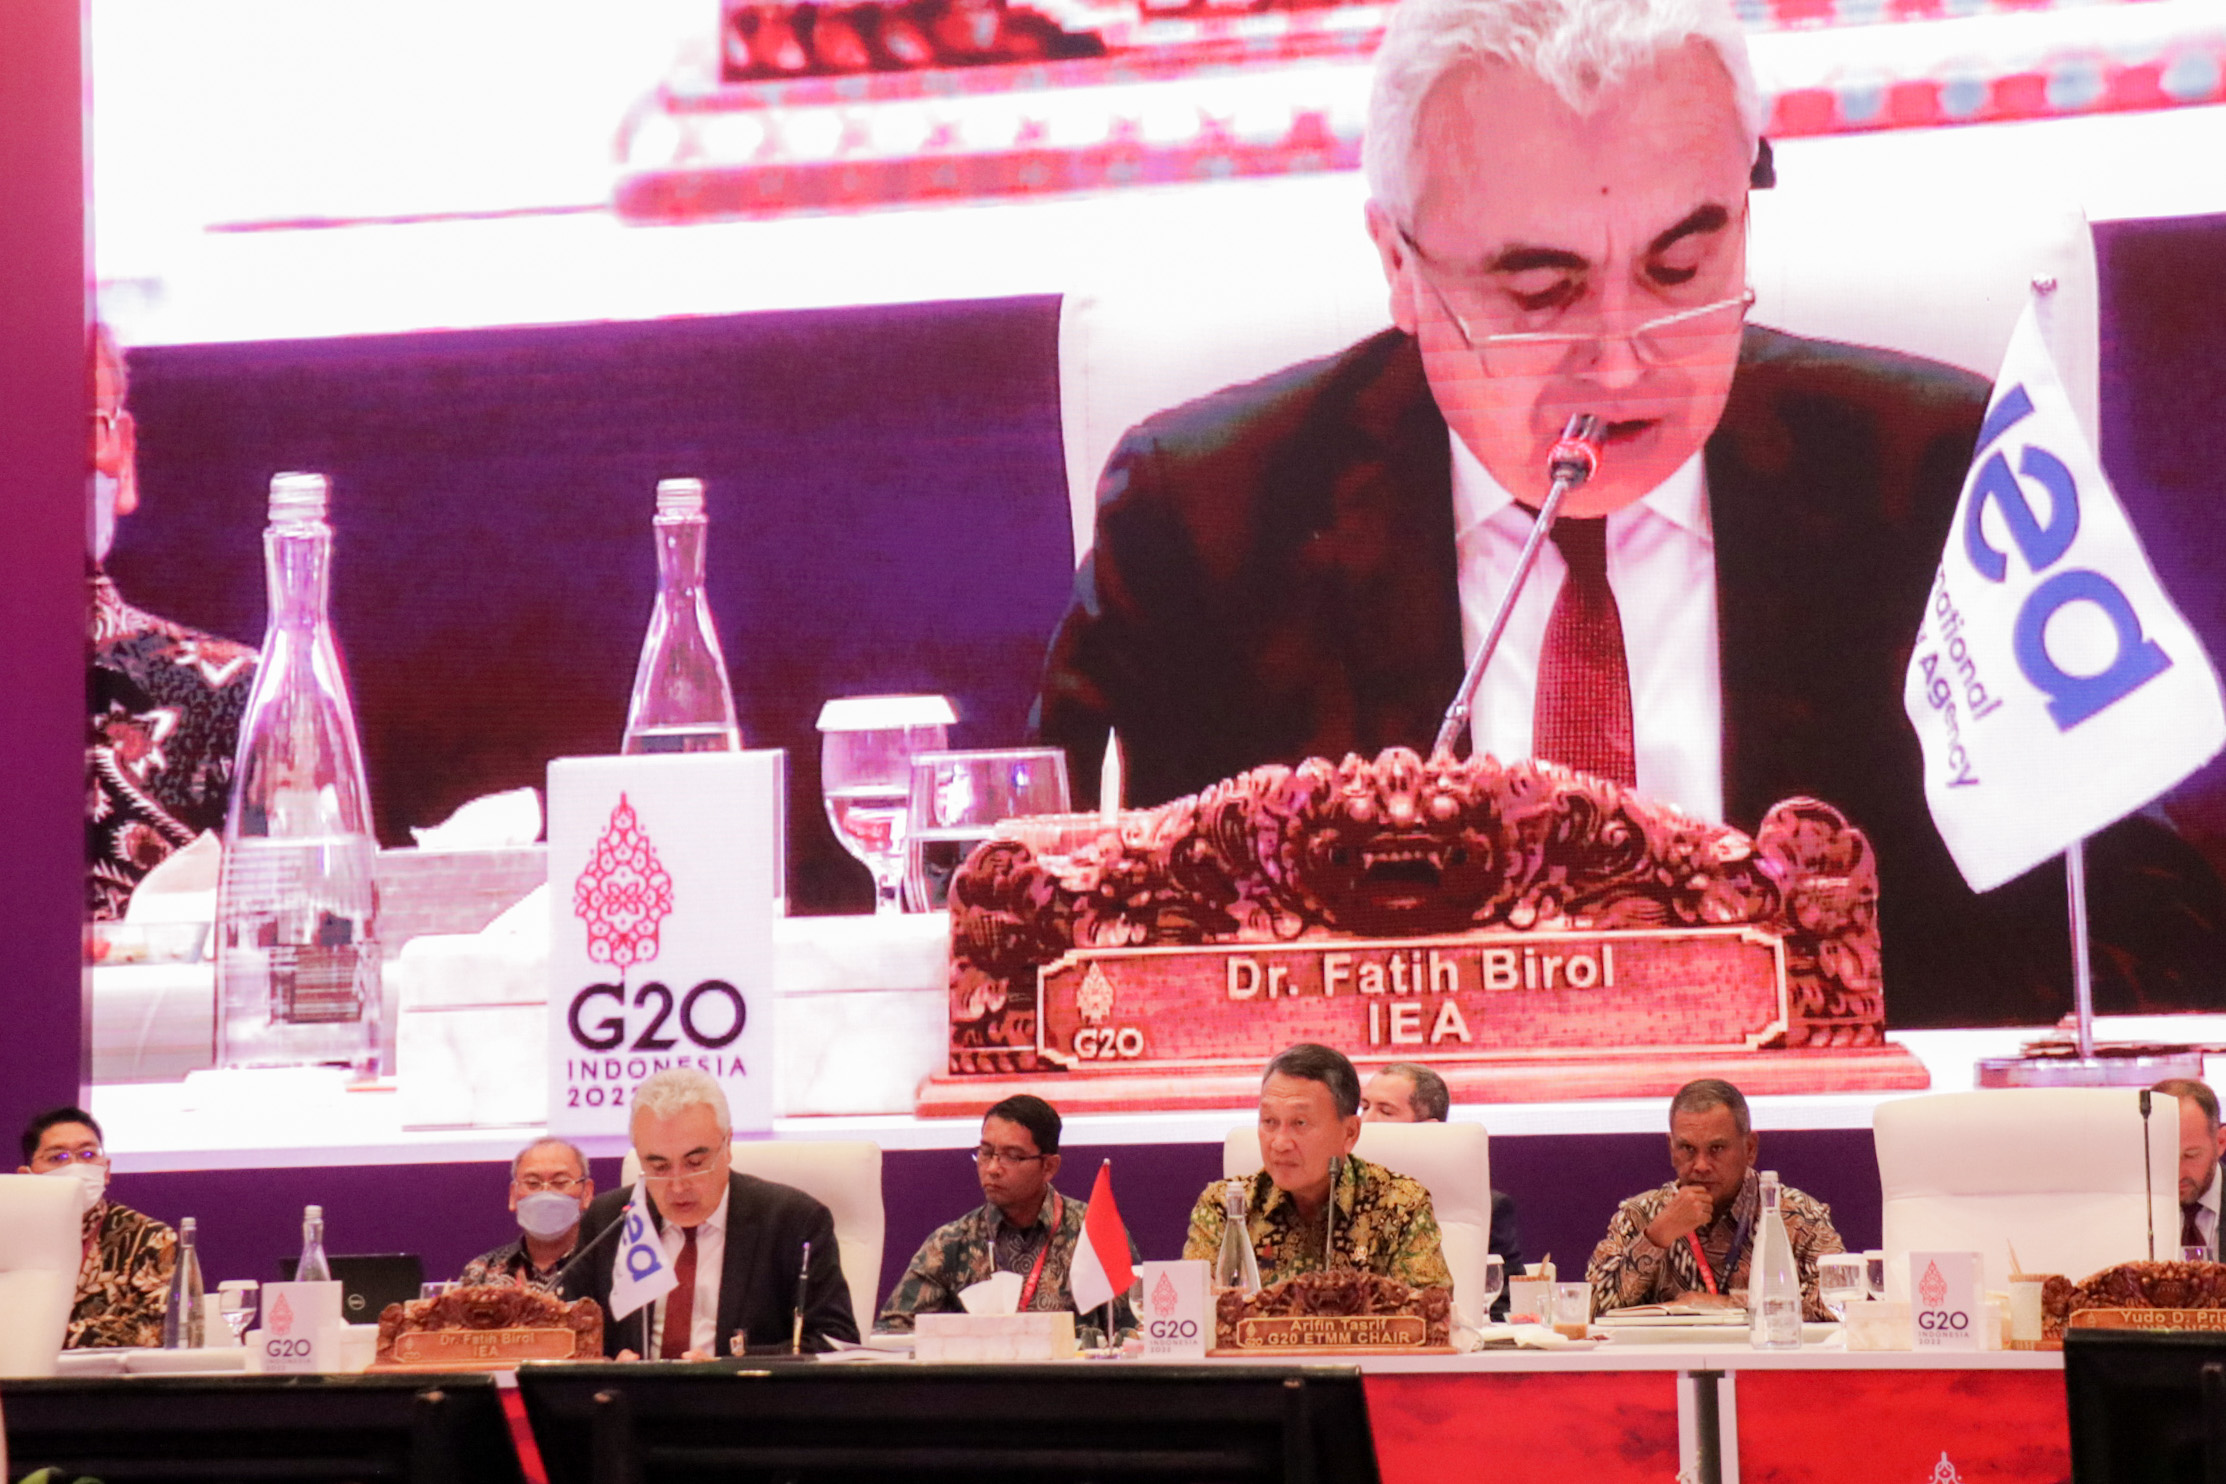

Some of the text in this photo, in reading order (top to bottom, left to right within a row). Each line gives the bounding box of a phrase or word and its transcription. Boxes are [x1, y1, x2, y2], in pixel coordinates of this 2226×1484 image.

[1919, 652, 1980, 788] Agency
[1227, 944, 1614, 1000] Dr. Fatih Birol
[568, 979, 747, 1052] G20
[1369, 999, 1472, 1045] IEA
[1074, 1027, 1144, 1058] G20
[568, 1086, 638, 1107] 202
[1291, 1319, 1388, 1331] Arifin Tasrif
[1918, 1311, 1969, 1330] G20
[2120, 1311, 2165, 1323] Yudo
[2172, 1311, 2190, 1323] D.
[441, 1332, 535, 1346] Dr. Fatih Birol
[1150, 1320, 1198, 1339] G20
[1268, 1331, 1410, 1345] G20 ETMM CHAIR
[266, 1339, 312, 1357] G20
[473, 1345, 500, 1358] IEA
